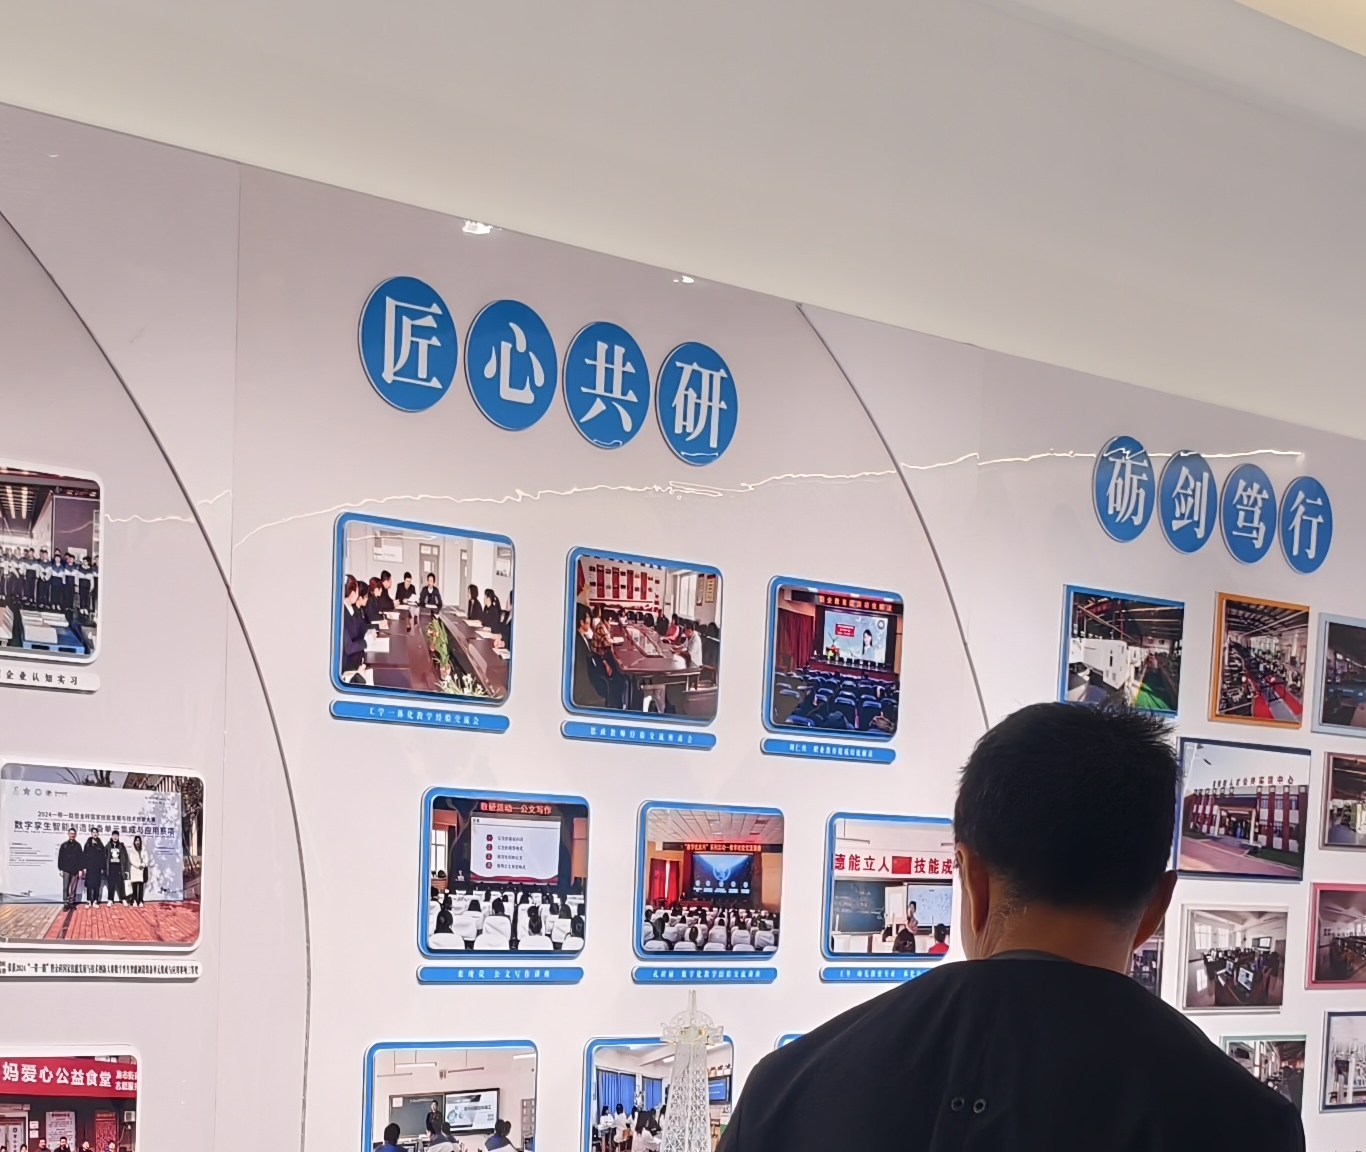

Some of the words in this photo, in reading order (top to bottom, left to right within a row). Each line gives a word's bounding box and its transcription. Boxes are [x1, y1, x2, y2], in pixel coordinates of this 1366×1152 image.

[381, 295, 728, 449] 匠心共研
[1105, 455, 1324, 559] 砺剑笃行
